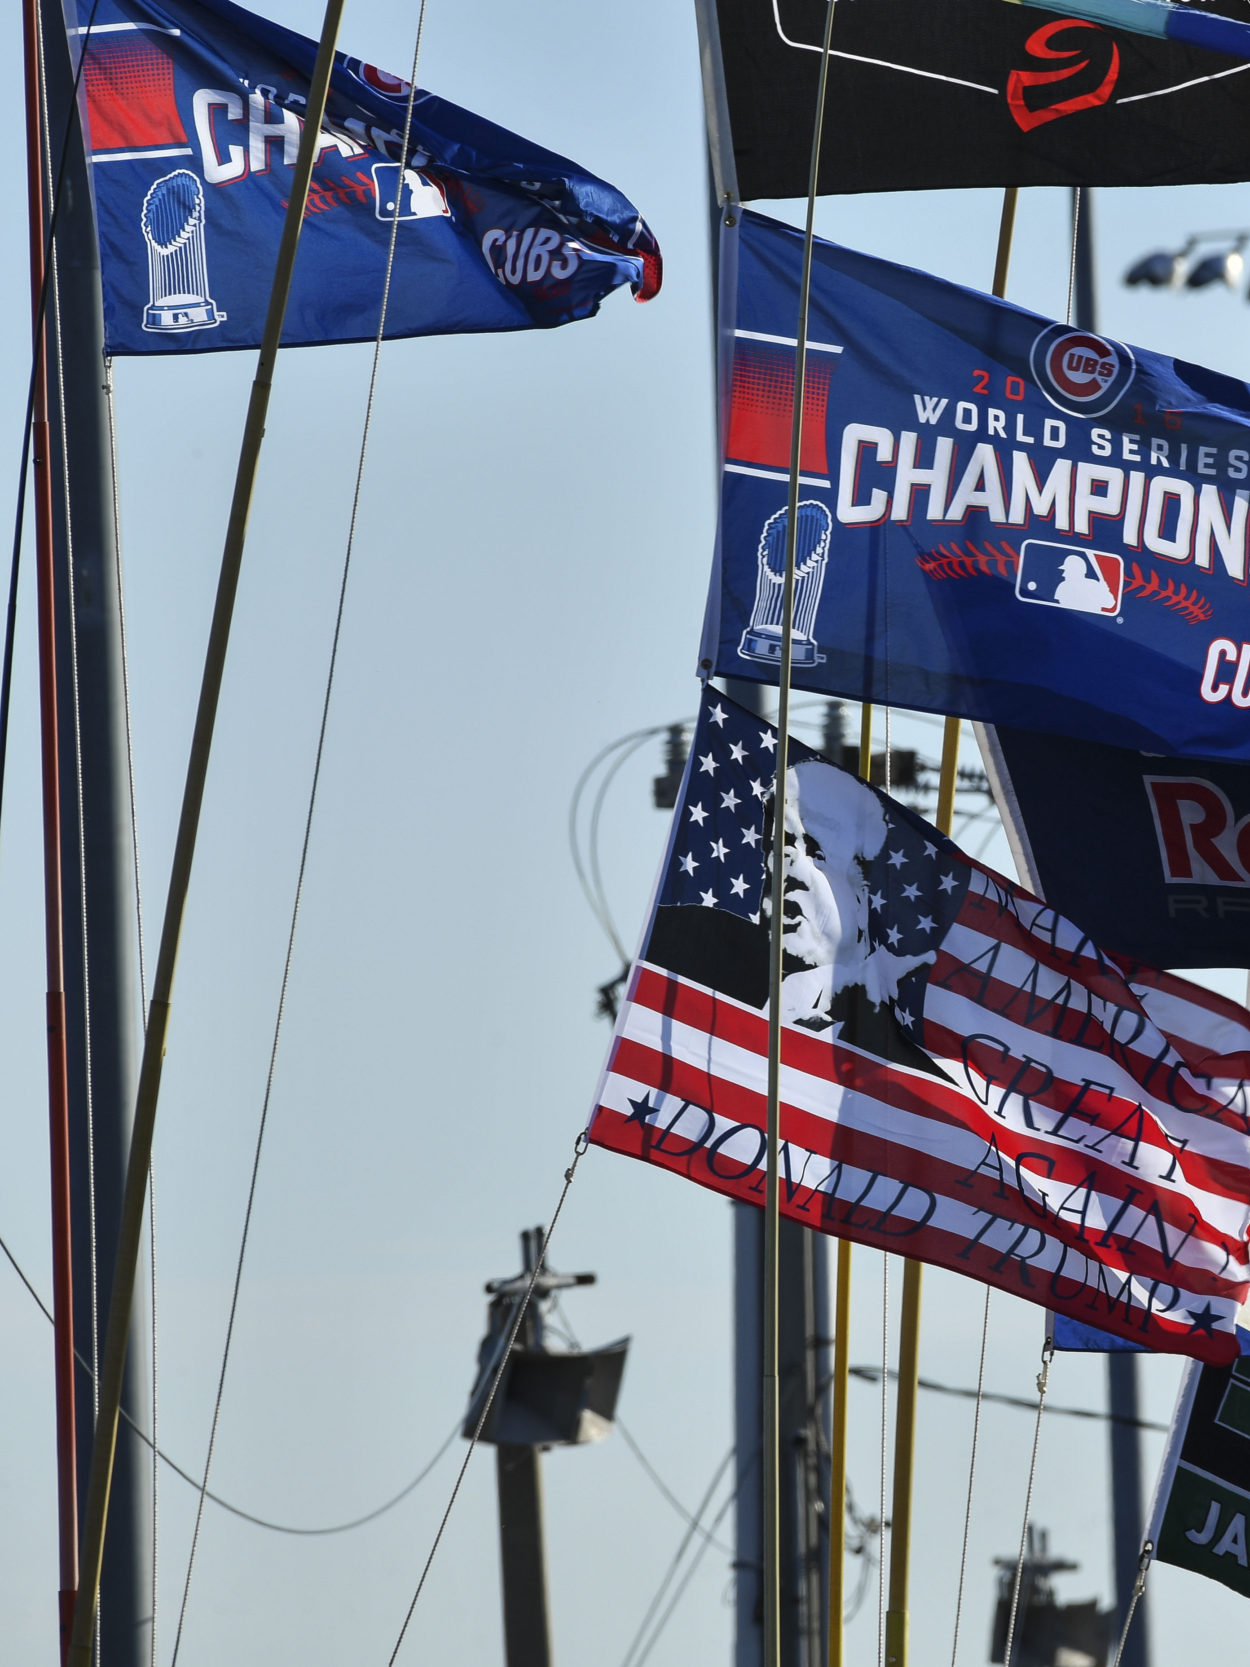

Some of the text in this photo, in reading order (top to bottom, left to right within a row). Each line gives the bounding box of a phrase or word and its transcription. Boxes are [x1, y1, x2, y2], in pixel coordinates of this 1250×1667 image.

[482, 227, 580, 286] CUBS
[972, 369, 1025, 402] 20
[913, 394, 1249, 480] WORLD SERIES
[961, 1032, 1190, 1183] GREAT
[651, 1096, 1181, 1333] DONALD TRUMP
